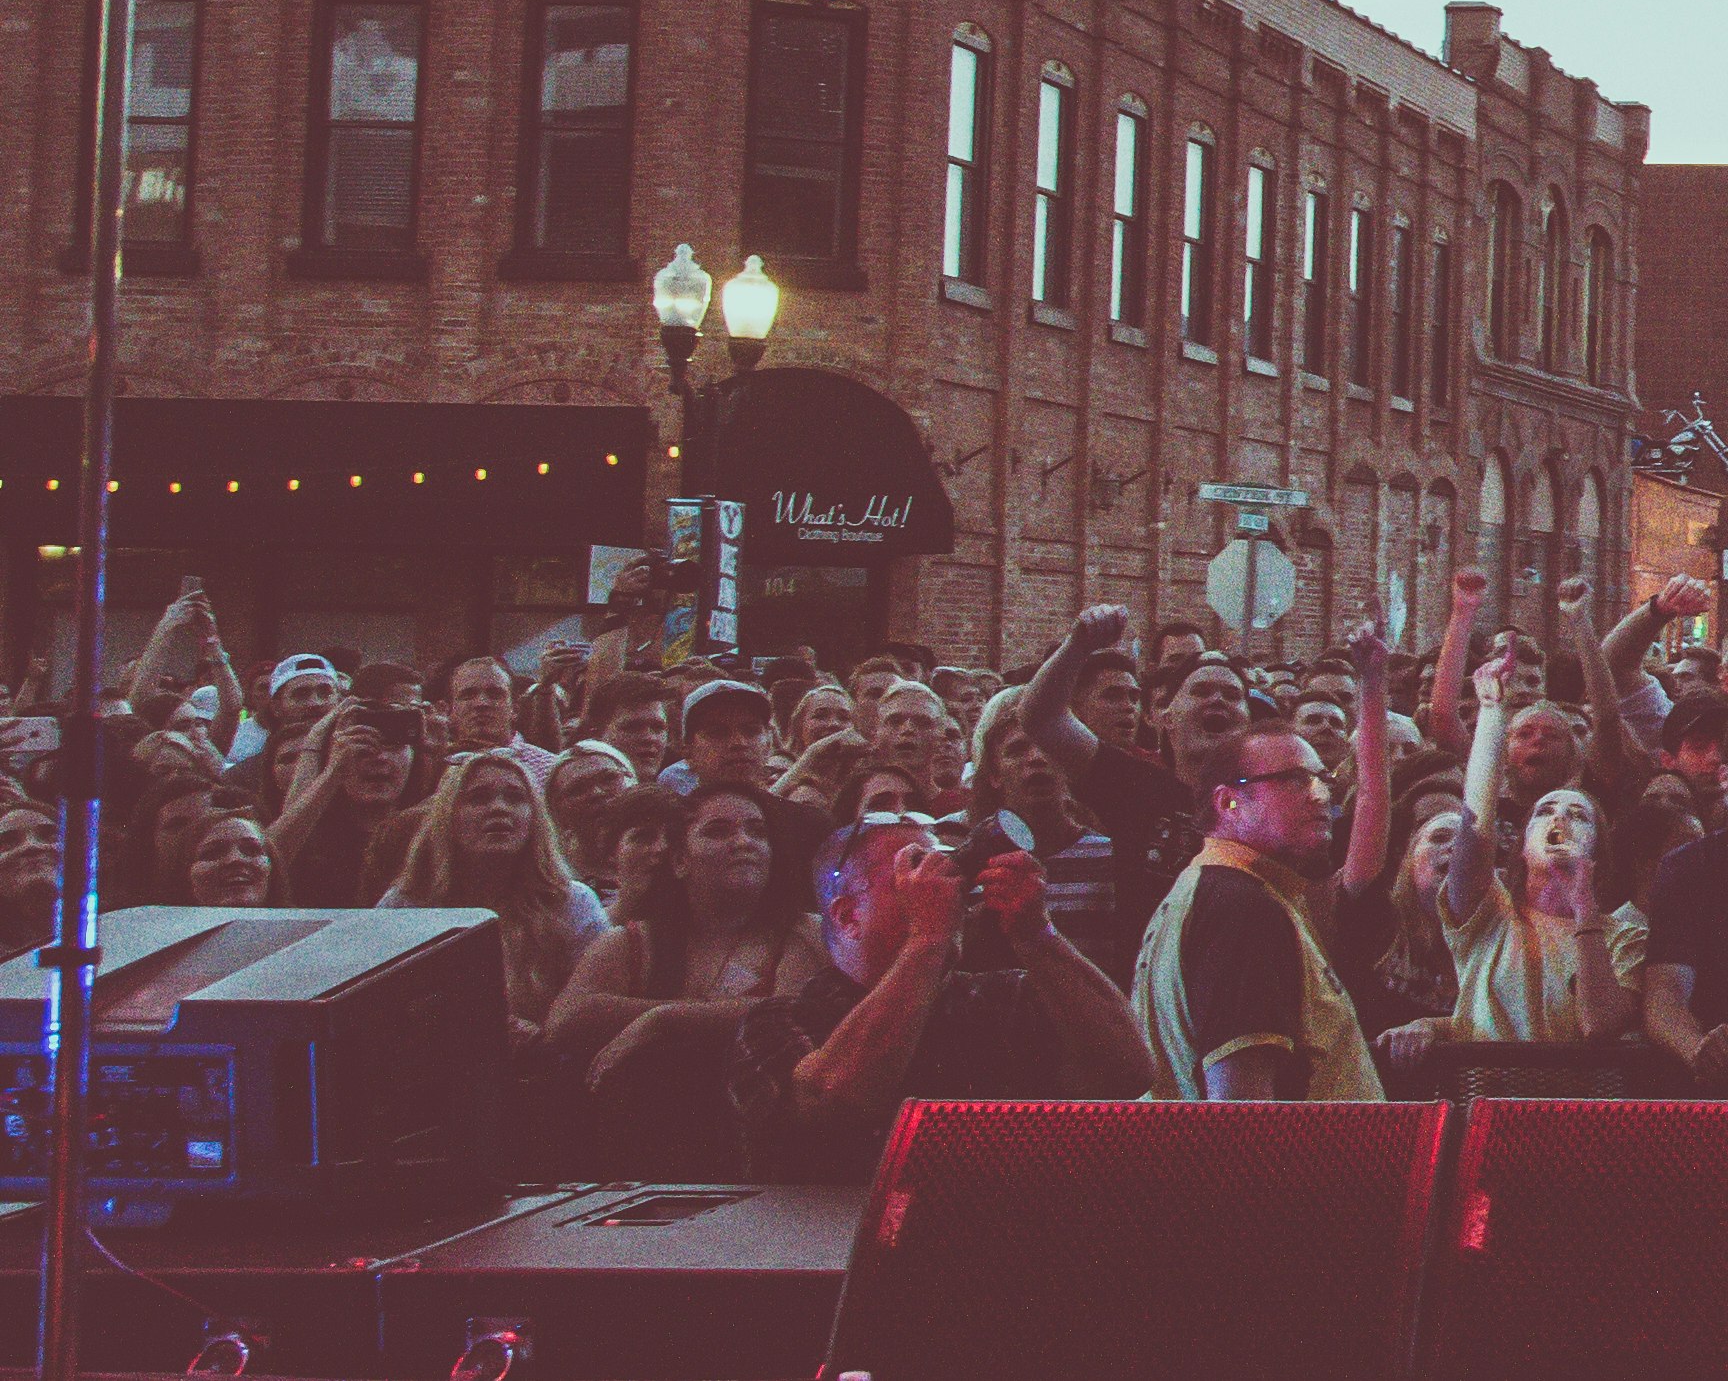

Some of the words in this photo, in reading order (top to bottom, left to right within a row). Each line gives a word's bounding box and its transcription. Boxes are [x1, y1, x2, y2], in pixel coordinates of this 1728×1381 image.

[771, 491, 847, 526] What's
[847, 494, 913, 529] Hot!
[763, 576, 796, 597] 104
